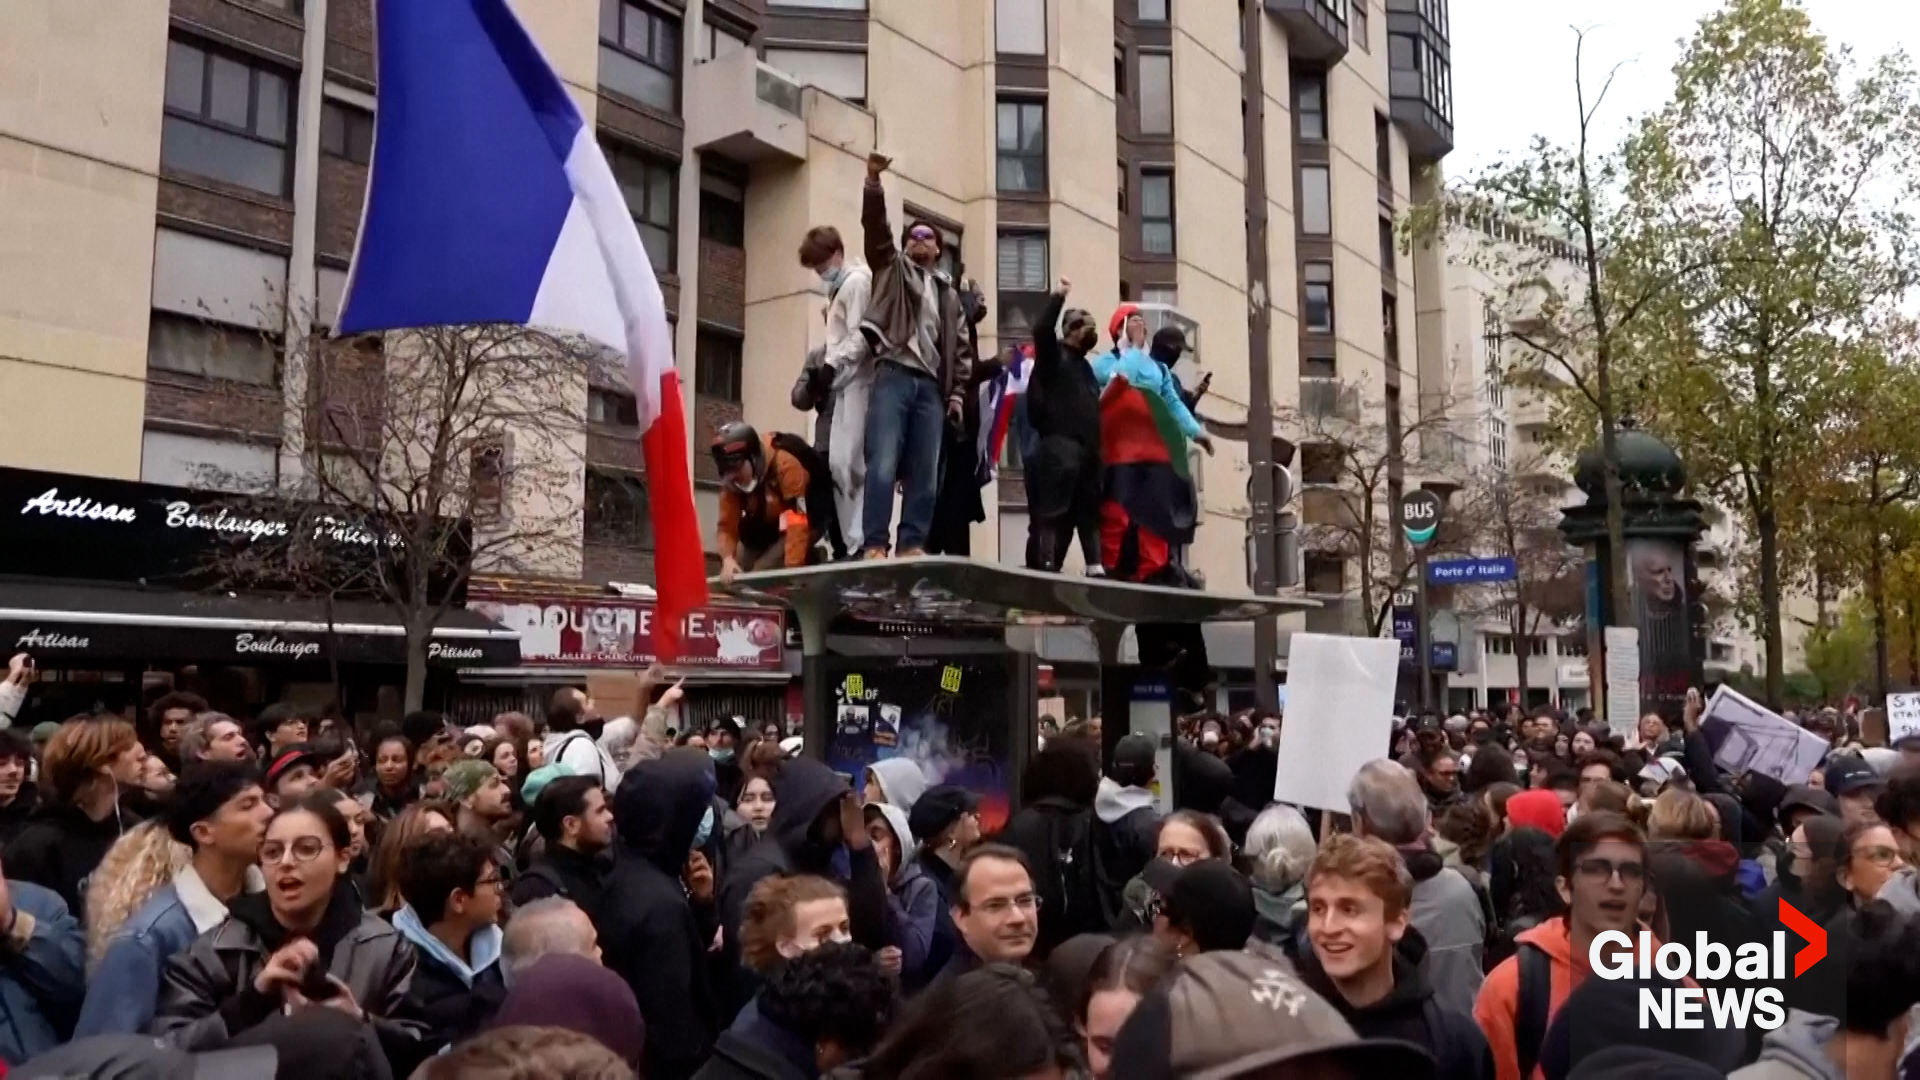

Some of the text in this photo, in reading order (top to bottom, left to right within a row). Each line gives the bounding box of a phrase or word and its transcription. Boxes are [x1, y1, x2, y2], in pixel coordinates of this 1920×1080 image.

[21, 487, 137, 523] Artisan
[165, 500, 289, 542] Boulanger
[1404, 501, 1434, 519] BUS
[1435, 566, 1463, 577] Porte
[1478, 563, 1506, 575] Italie
[15, 627, 483, 660] Artisan Boulanger Pâtissier
